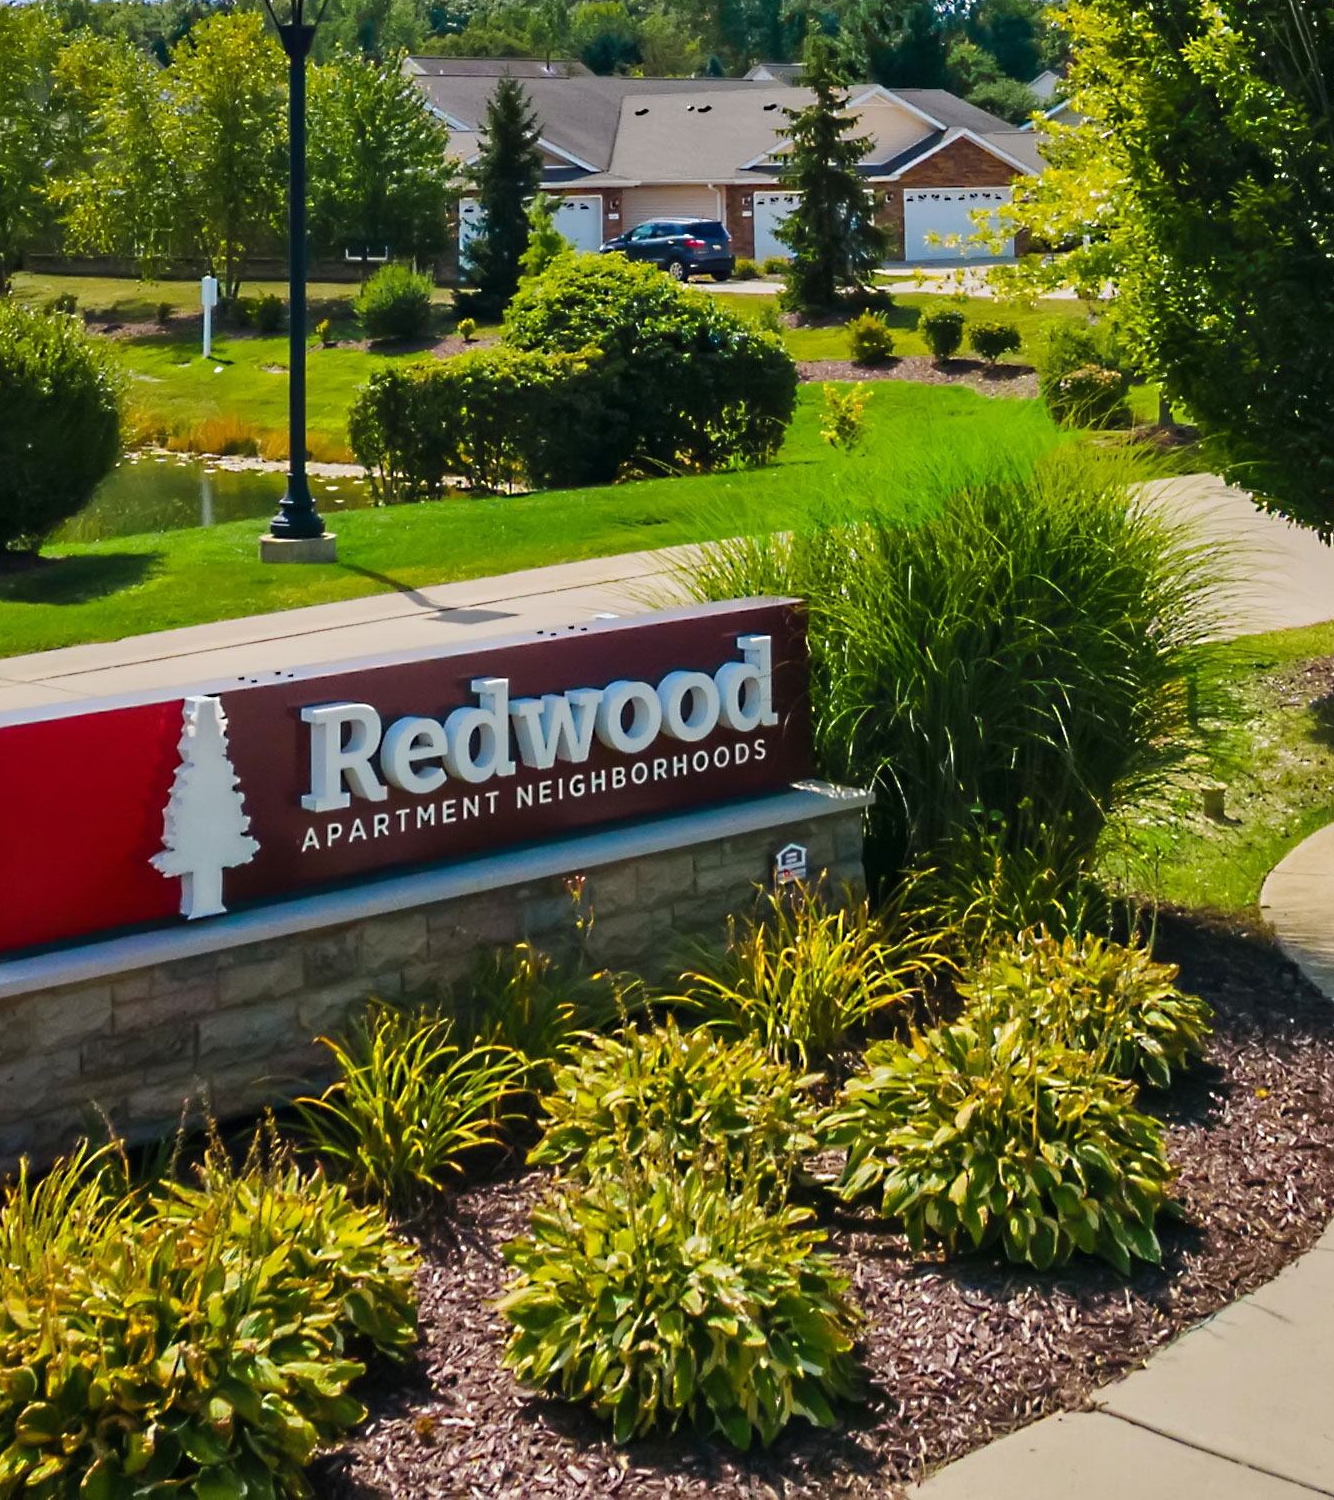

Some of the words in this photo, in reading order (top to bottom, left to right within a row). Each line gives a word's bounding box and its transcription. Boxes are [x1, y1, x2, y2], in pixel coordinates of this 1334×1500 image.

[300, 634, 779, 813] Redwood
[301, 791, 500, 852] APARTMENT
[516, 738, 767, 809] NEIGHBORHOODS
